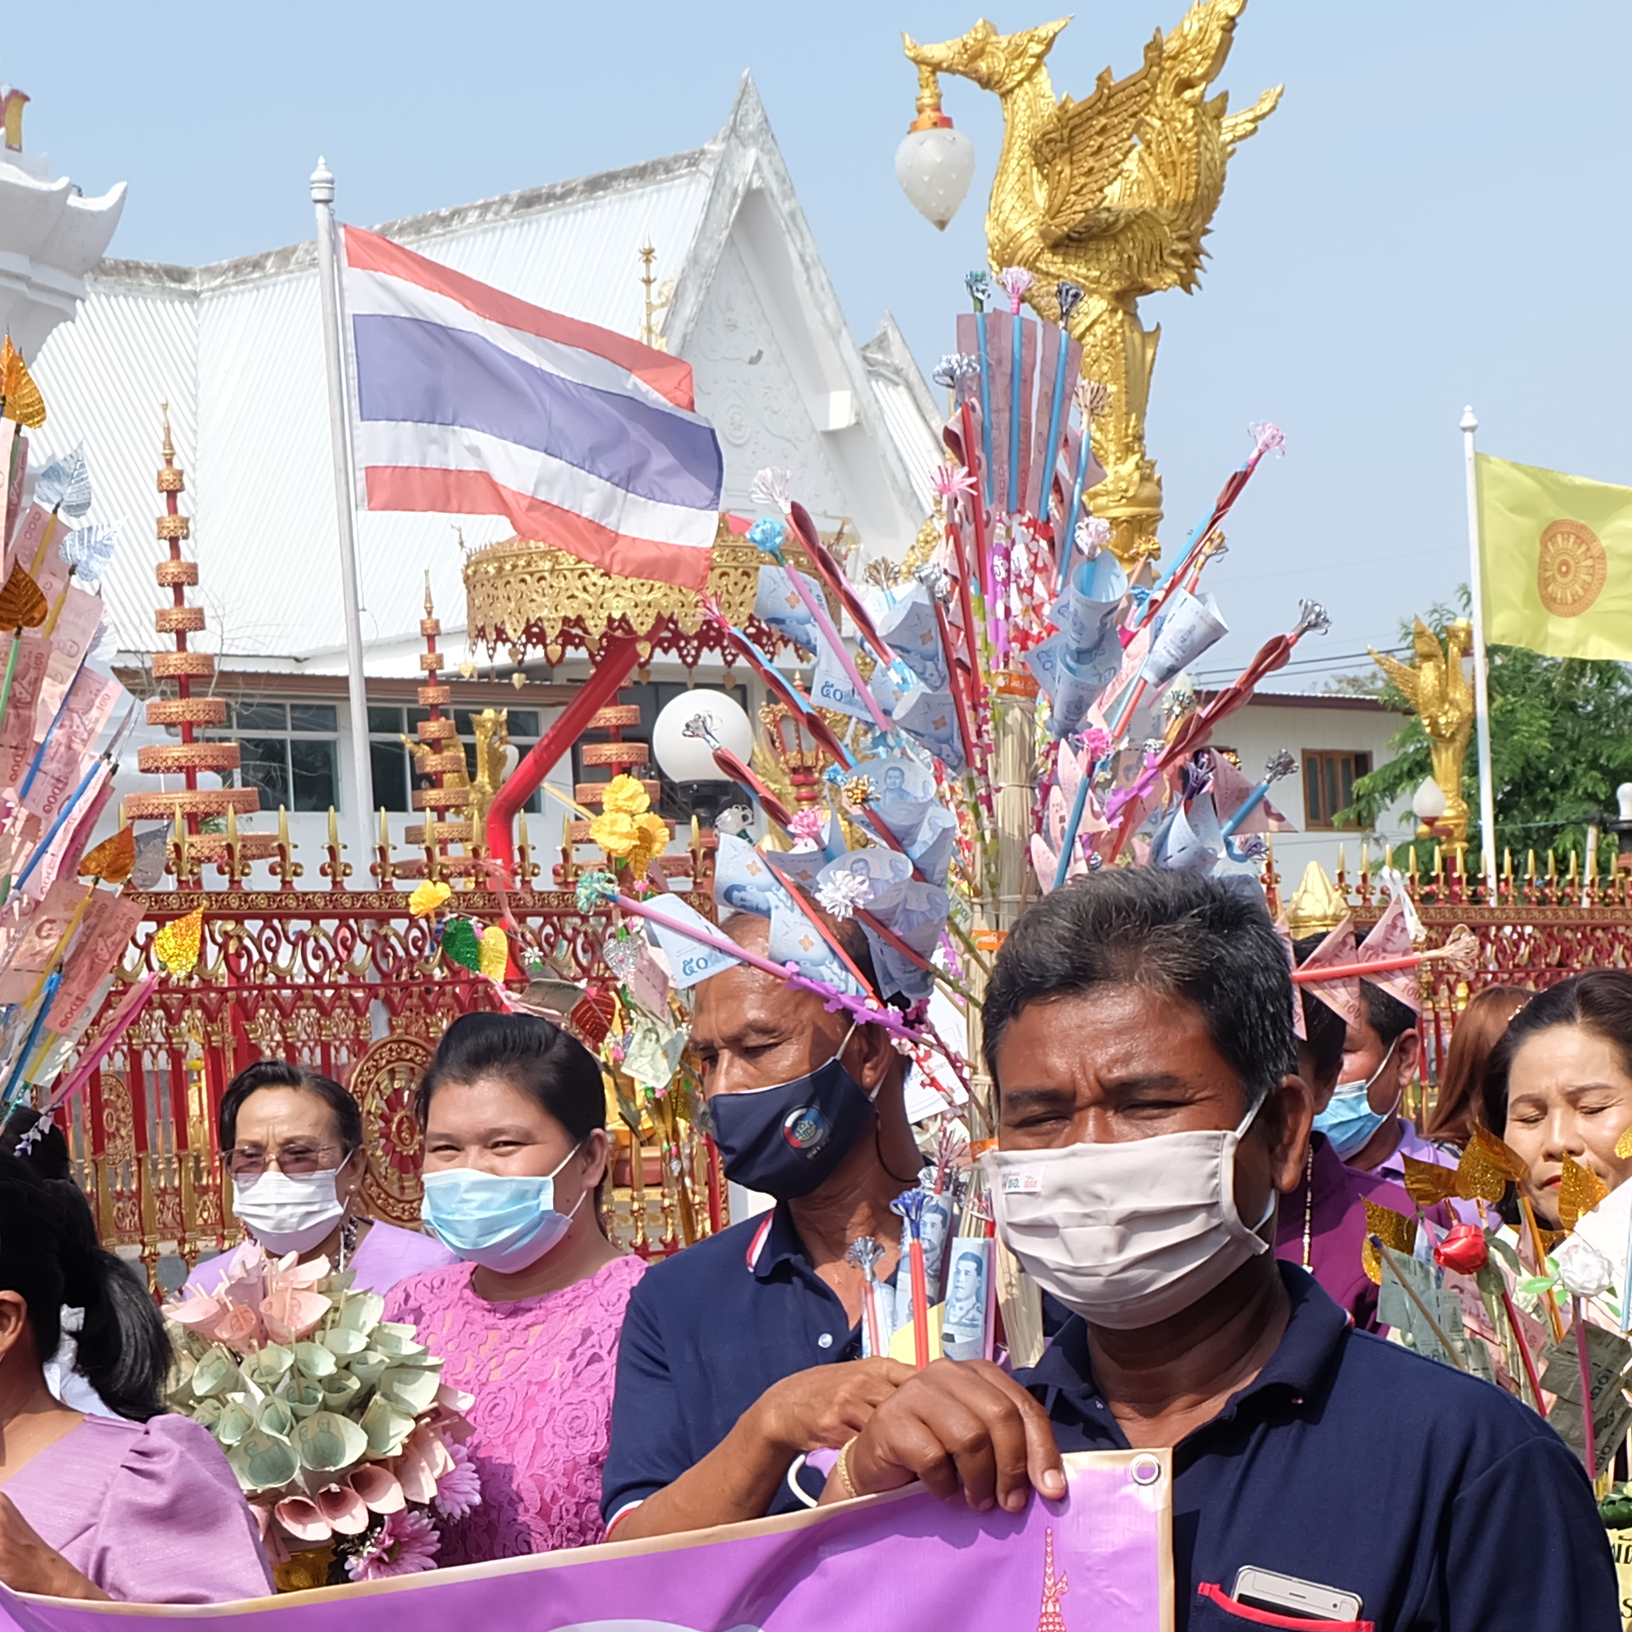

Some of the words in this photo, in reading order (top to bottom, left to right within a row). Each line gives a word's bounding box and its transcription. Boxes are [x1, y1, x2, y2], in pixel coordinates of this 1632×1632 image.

[820, 679, 845, 703] ๕๐
[682, 952, 711, 976] ๕๐
[1401, 982, 1422, 1001] 100
[1341, 999, 1362, 1020] 100
